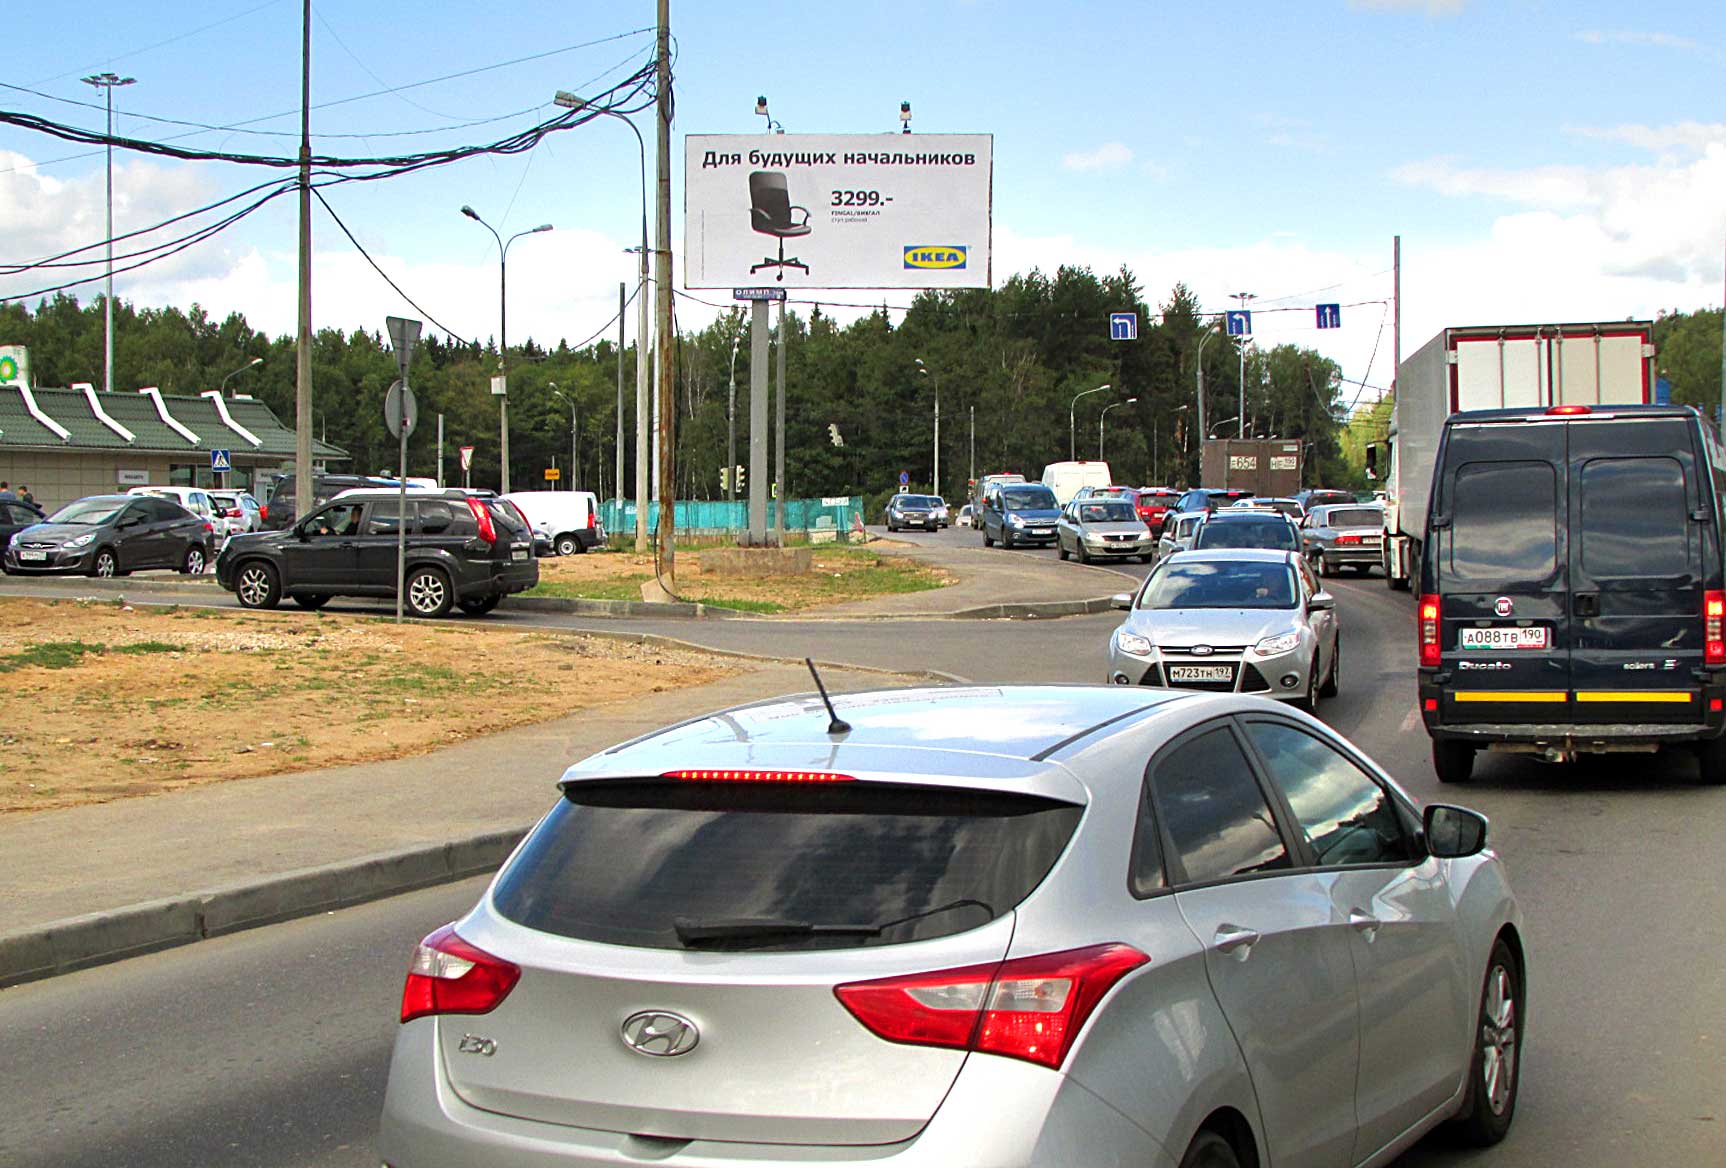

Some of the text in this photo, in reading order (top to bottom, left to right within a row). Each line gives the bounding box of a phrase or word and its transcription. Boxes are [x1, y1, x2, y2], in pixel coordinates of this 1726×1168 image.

[703, 150, 976, 168] Для будущих начальников
[831, 190, 893, 206] 3299.-
[911, 252, 960, 262] IKEA
[1521, 629, 1541, 640] 190
[1459, 661, 1512, 670] Ducato
[458, 1032, 498, 1057] i30
